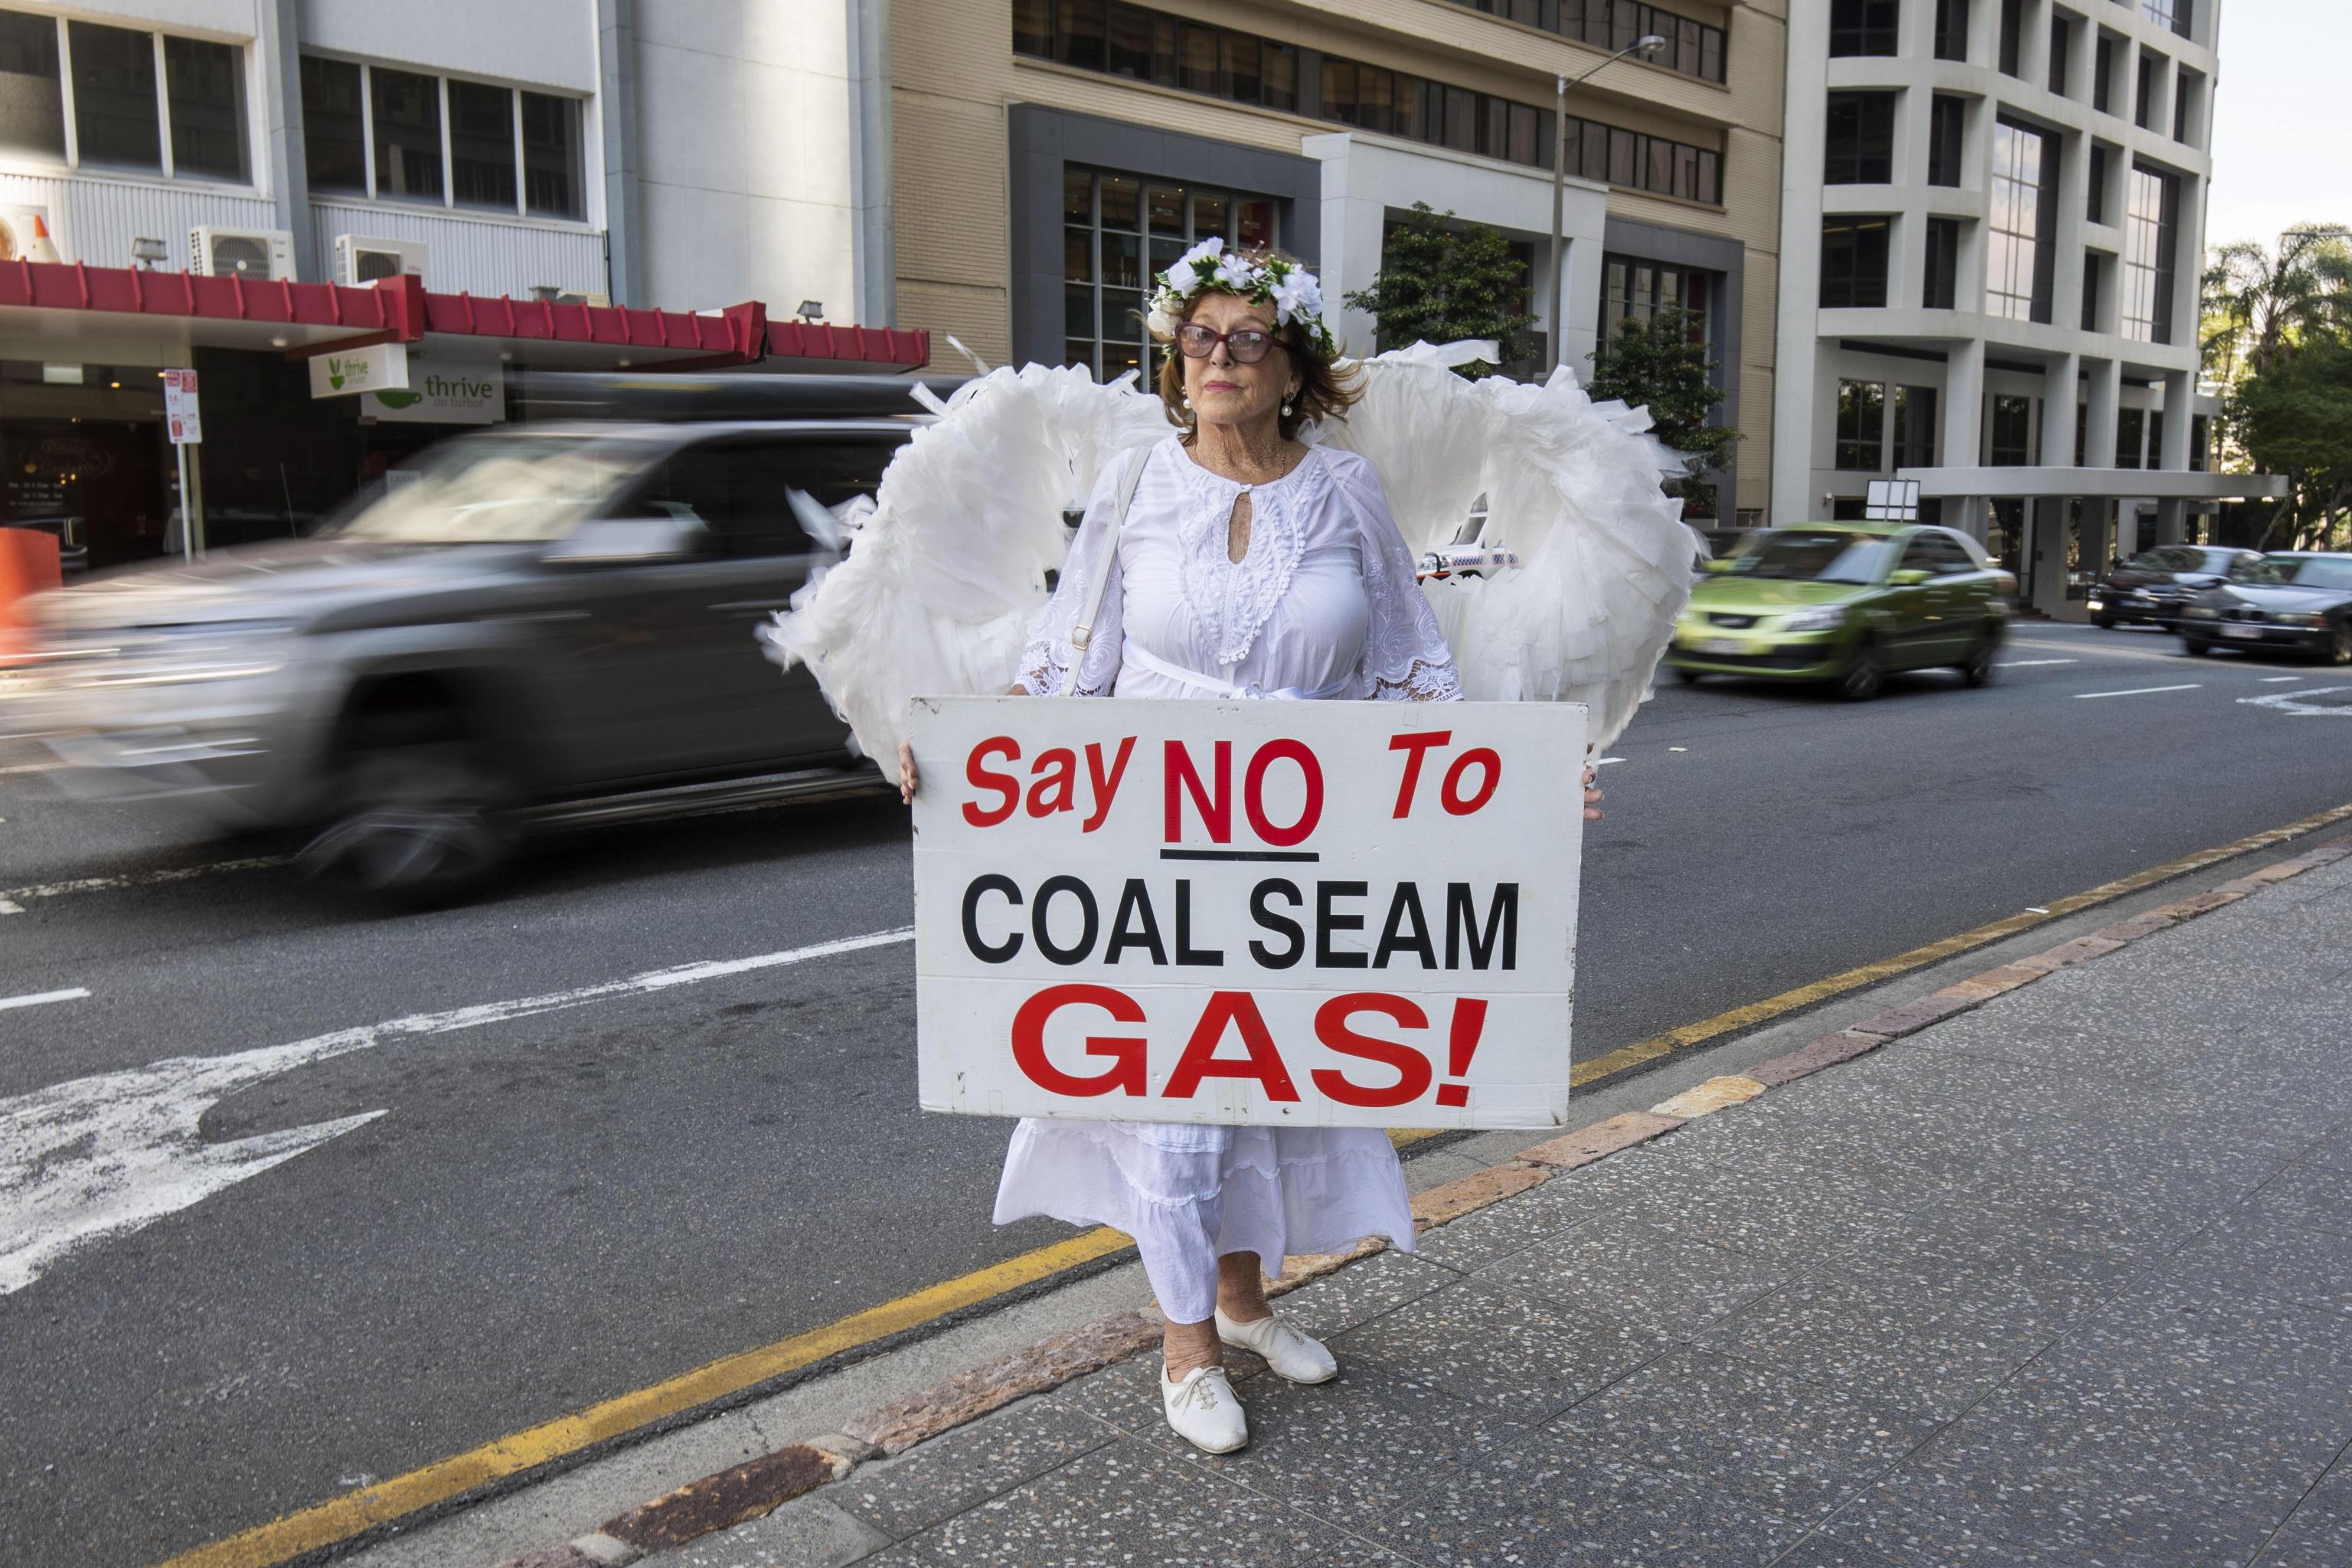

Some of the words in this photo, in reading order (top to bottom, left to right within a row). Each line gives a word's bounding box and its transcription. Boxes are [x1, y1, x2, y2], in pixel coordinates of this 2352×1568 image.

[345, 358, 368, 377] thrive
[425, 374, 492, 398] thrive
[434, 398, 448, 407] on
[451, 397, 484, 409] turbot
[962, 736, 1136, 833] Say
[1164, 738, 1325, 848] NO
[1388, 730, 1501, 819] To
[962, 874, 1224, 966] COAL
[1248, 877, 1519, 971] SEAM
[1011, 984, 1488, 1108] GAS!
